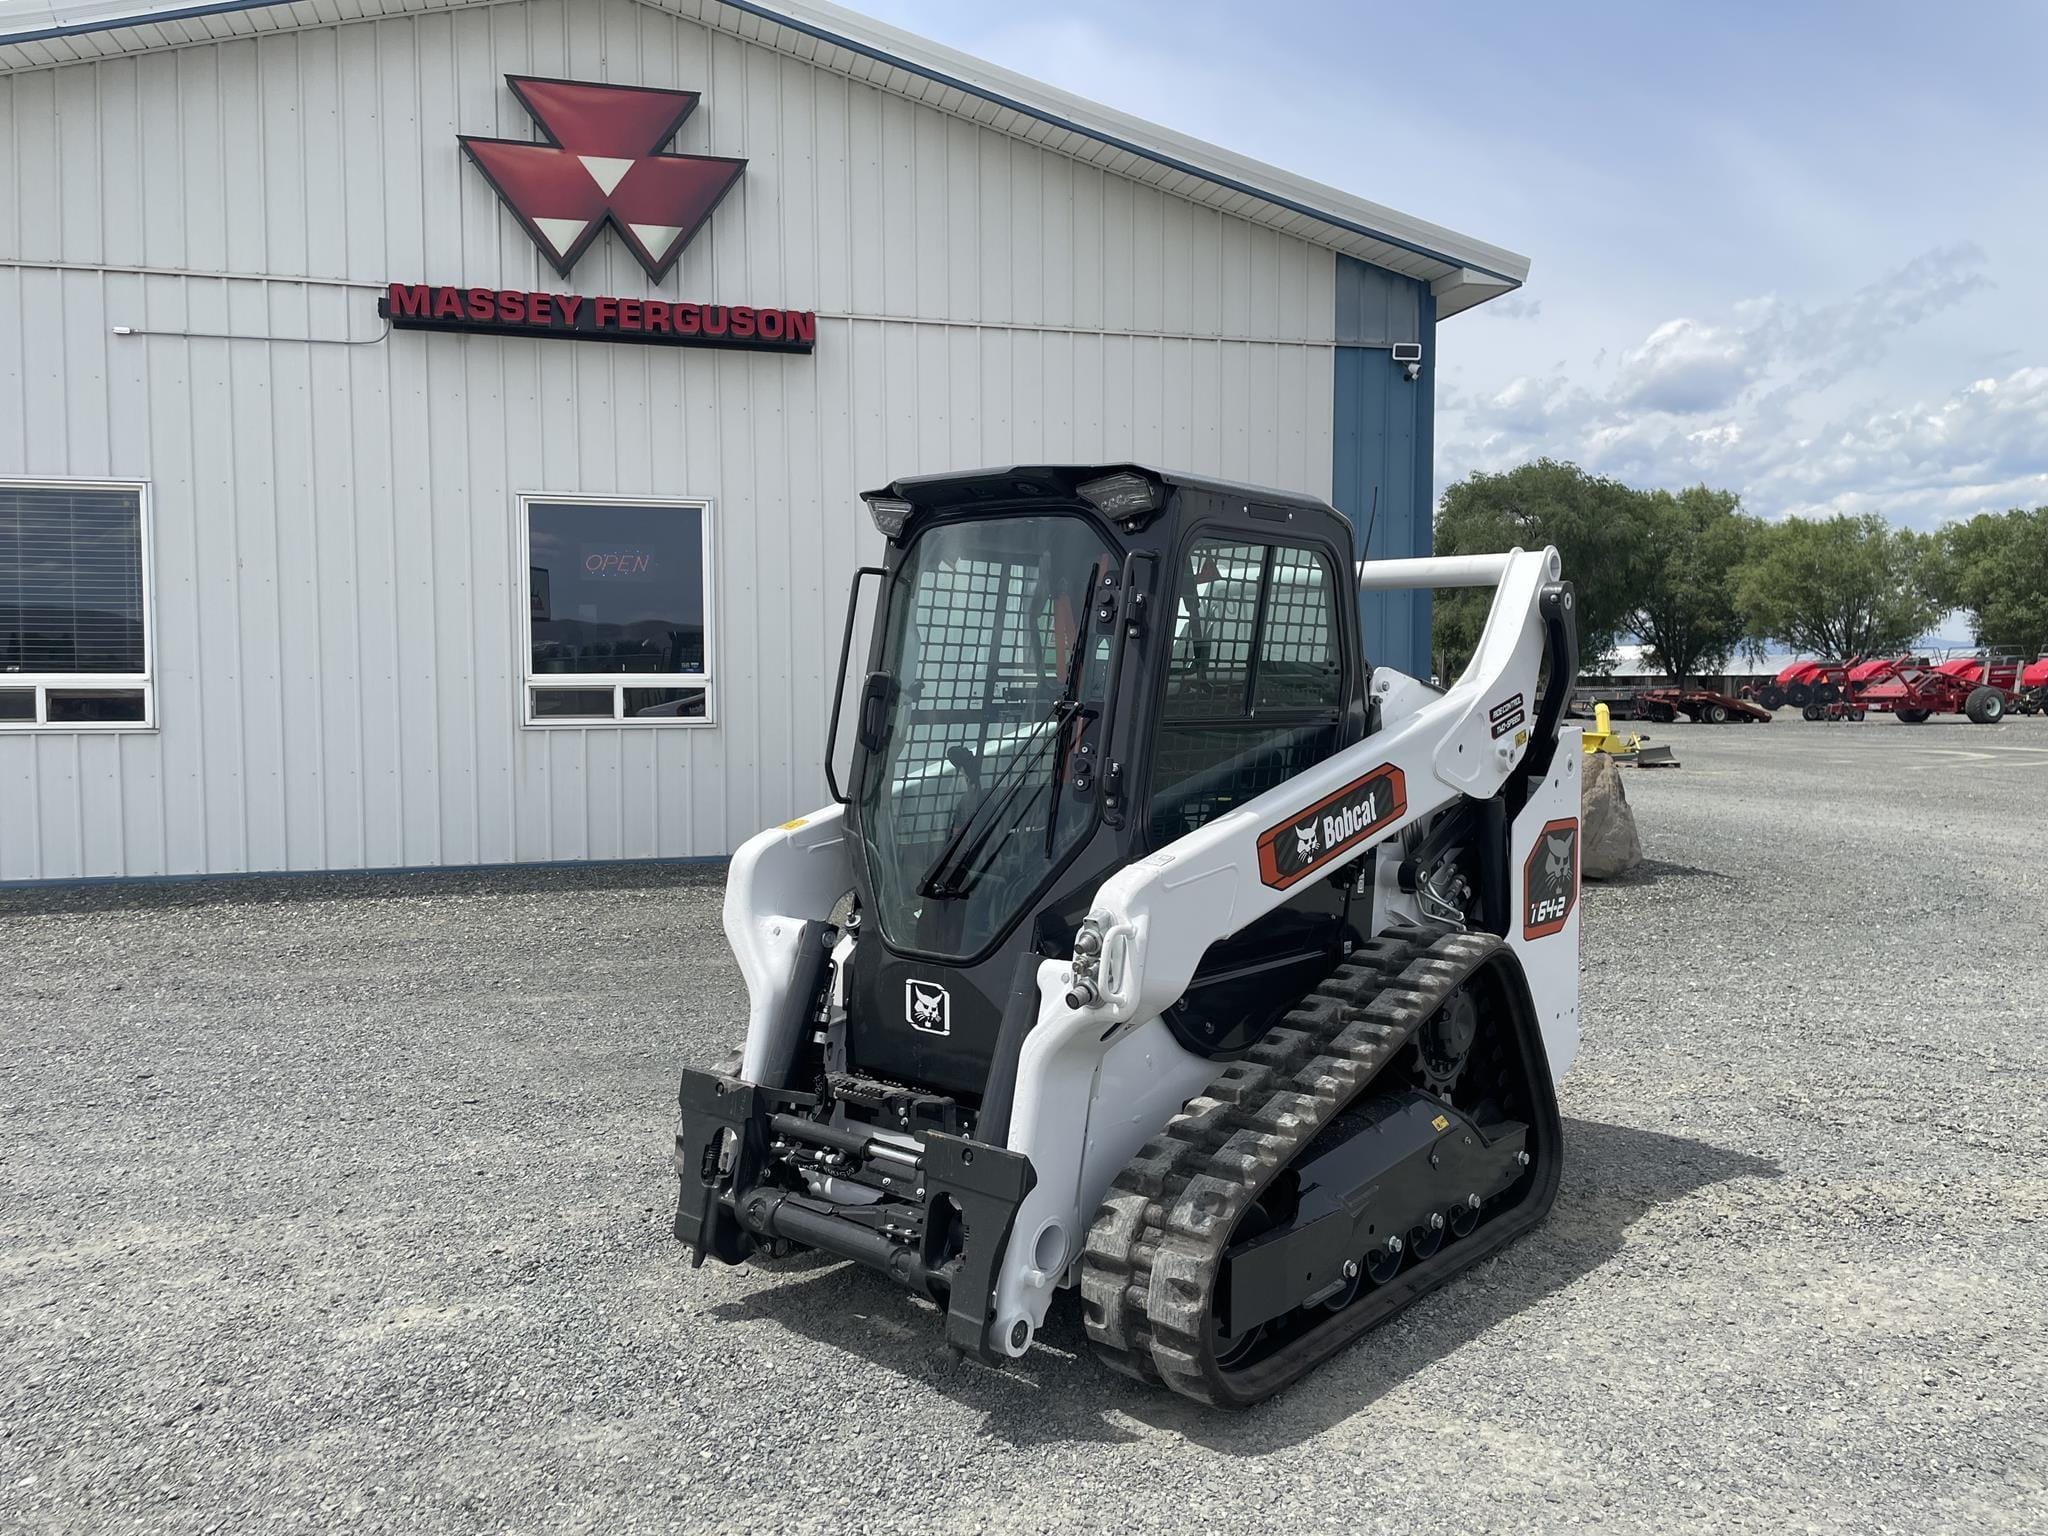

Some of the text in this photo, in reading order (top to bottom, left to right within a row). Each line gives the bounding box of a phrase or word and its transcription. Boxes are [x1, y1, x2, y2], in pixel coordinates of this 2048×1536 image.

[388, 283, 816, 342] MASSEY FERGUSON
[585, 554, 649, 572] OPEN
[1323, 792, 1376, 849] Bobcat
